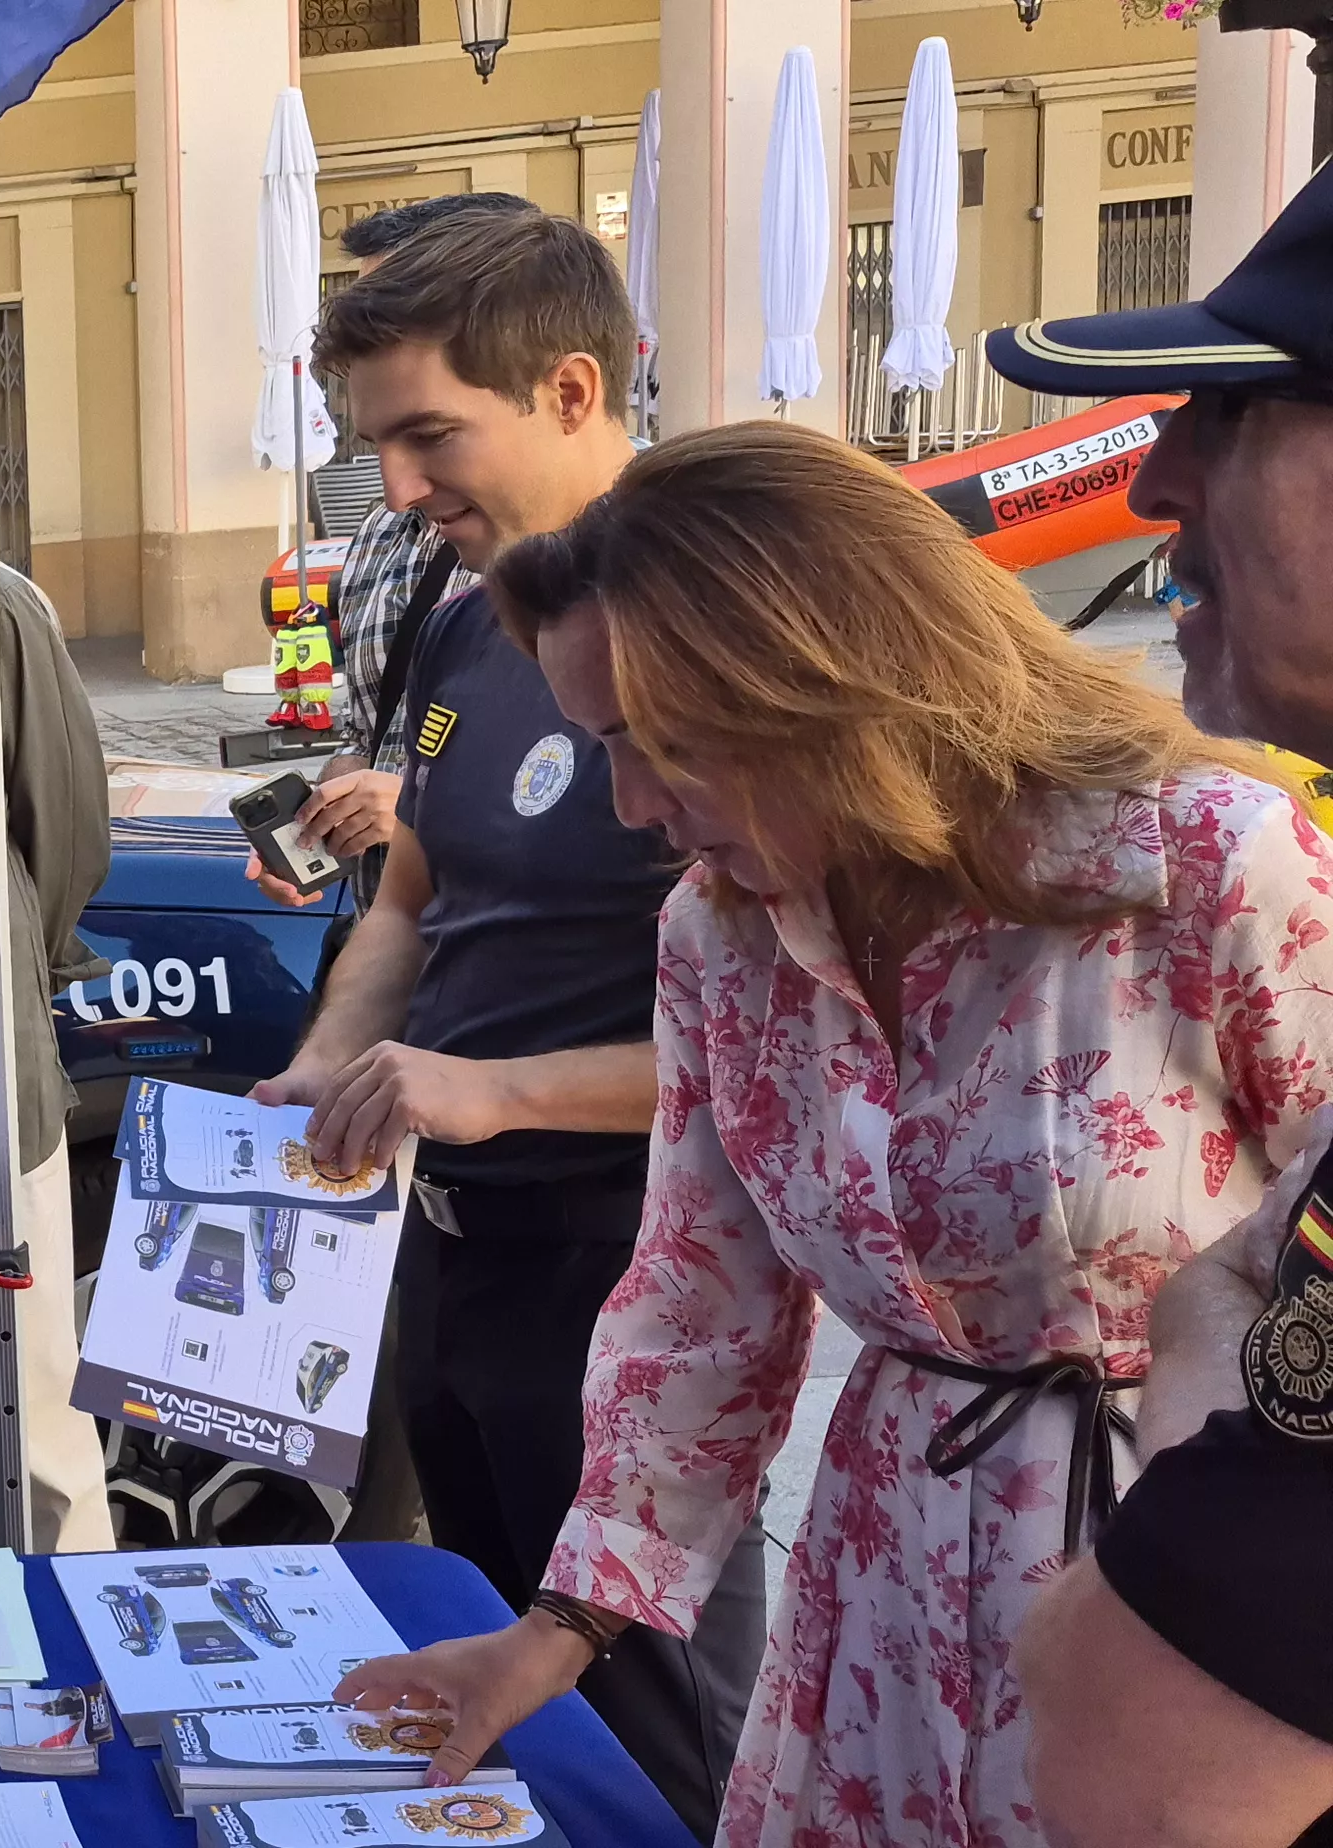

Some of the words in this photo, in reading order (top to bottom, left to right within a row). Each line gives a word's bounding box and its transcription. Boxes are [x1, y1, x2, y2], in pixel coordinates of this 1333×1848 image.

[1017, 423, 1149, 482] TA-3-5-2013
[110, 957, 232, 1018] 091
[139, 1128, 149, 1178] POLICIA
[146, 1115, 158, 1178] NACIONAL
[127, 1381, 282, 1437] NACIONAL
[155, 1407, 281, 1456] POLICIA
